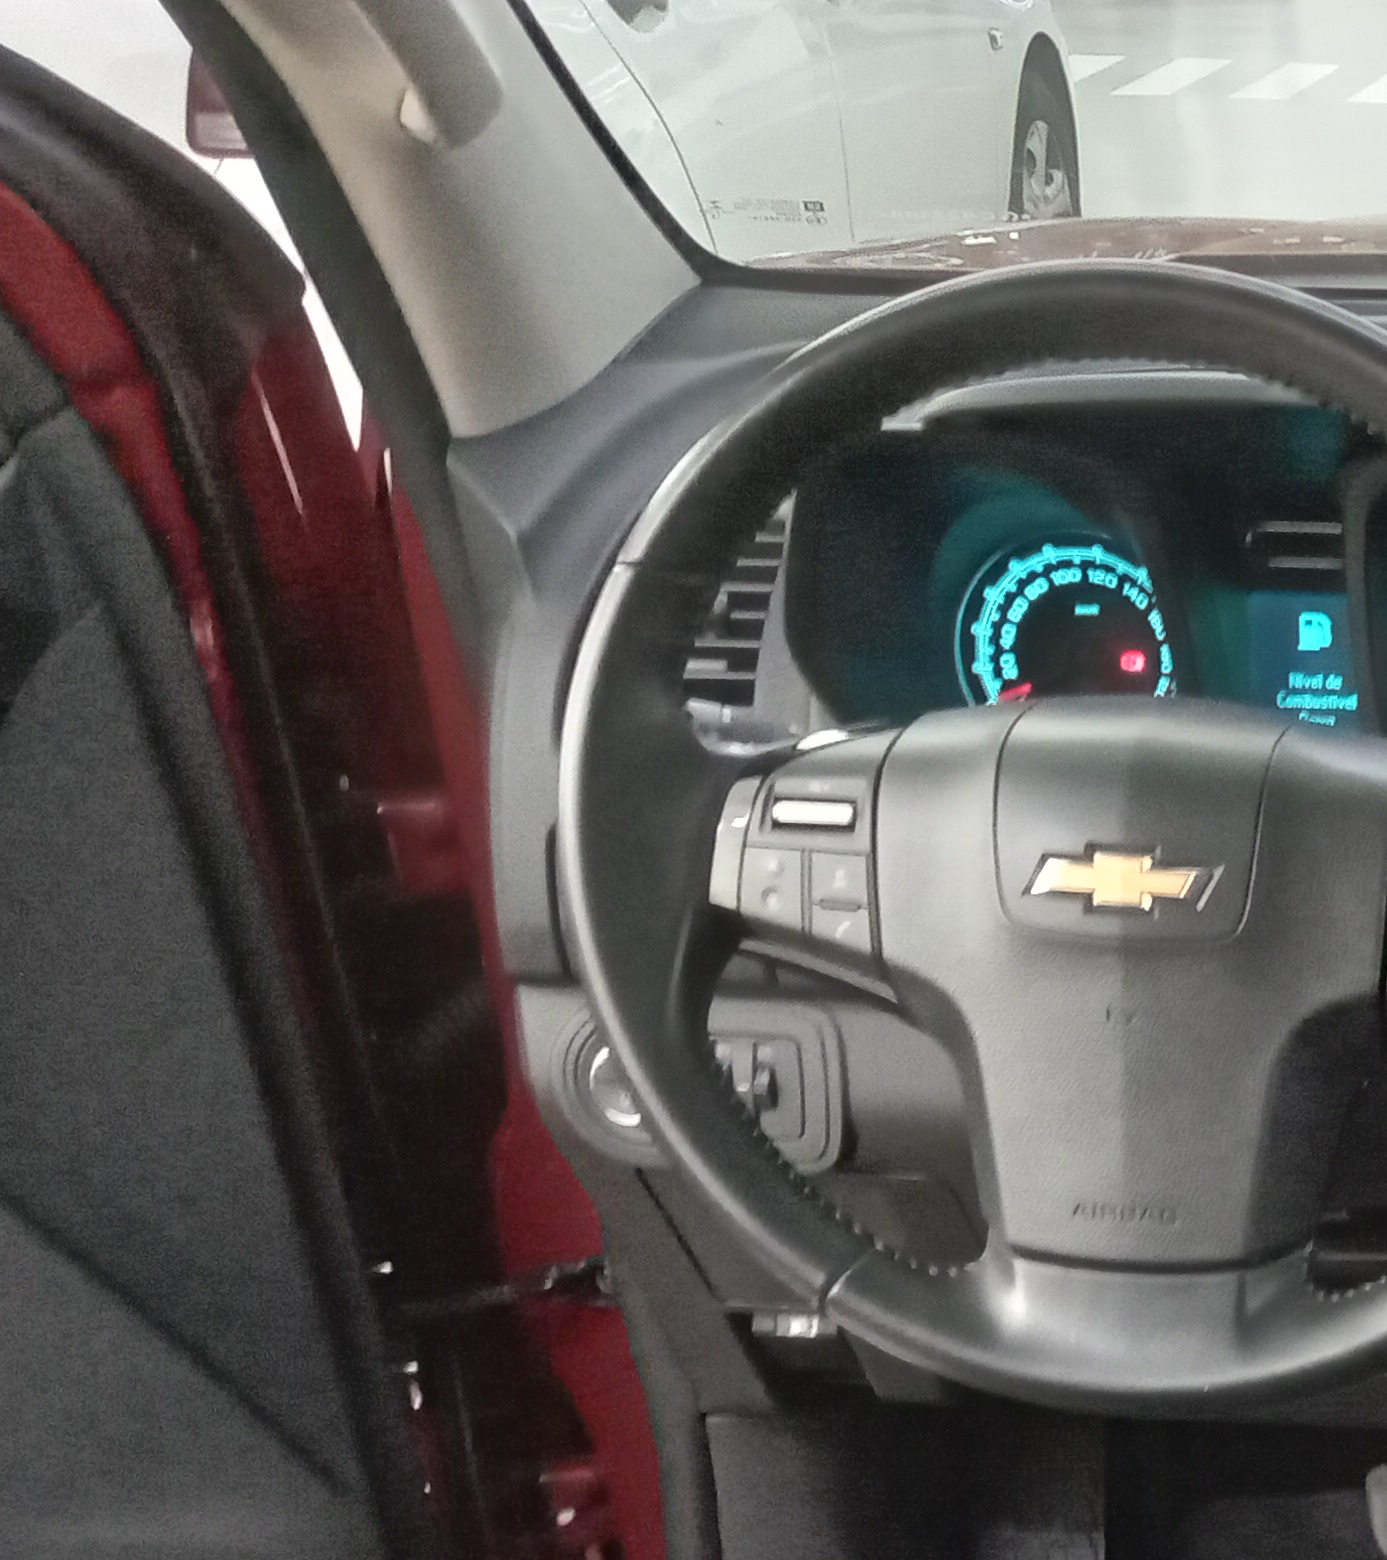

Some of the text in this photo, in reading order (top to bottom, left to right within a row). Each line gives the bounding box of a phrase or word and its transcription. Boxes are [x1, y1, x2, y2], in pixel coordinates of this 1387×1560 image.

[1050, 567, 1082, 586] 100
[1087, 568, 1118, 589] 120
[1123, 582, 1149, 610] 140
[1000, 623, 1017, 649] 40
